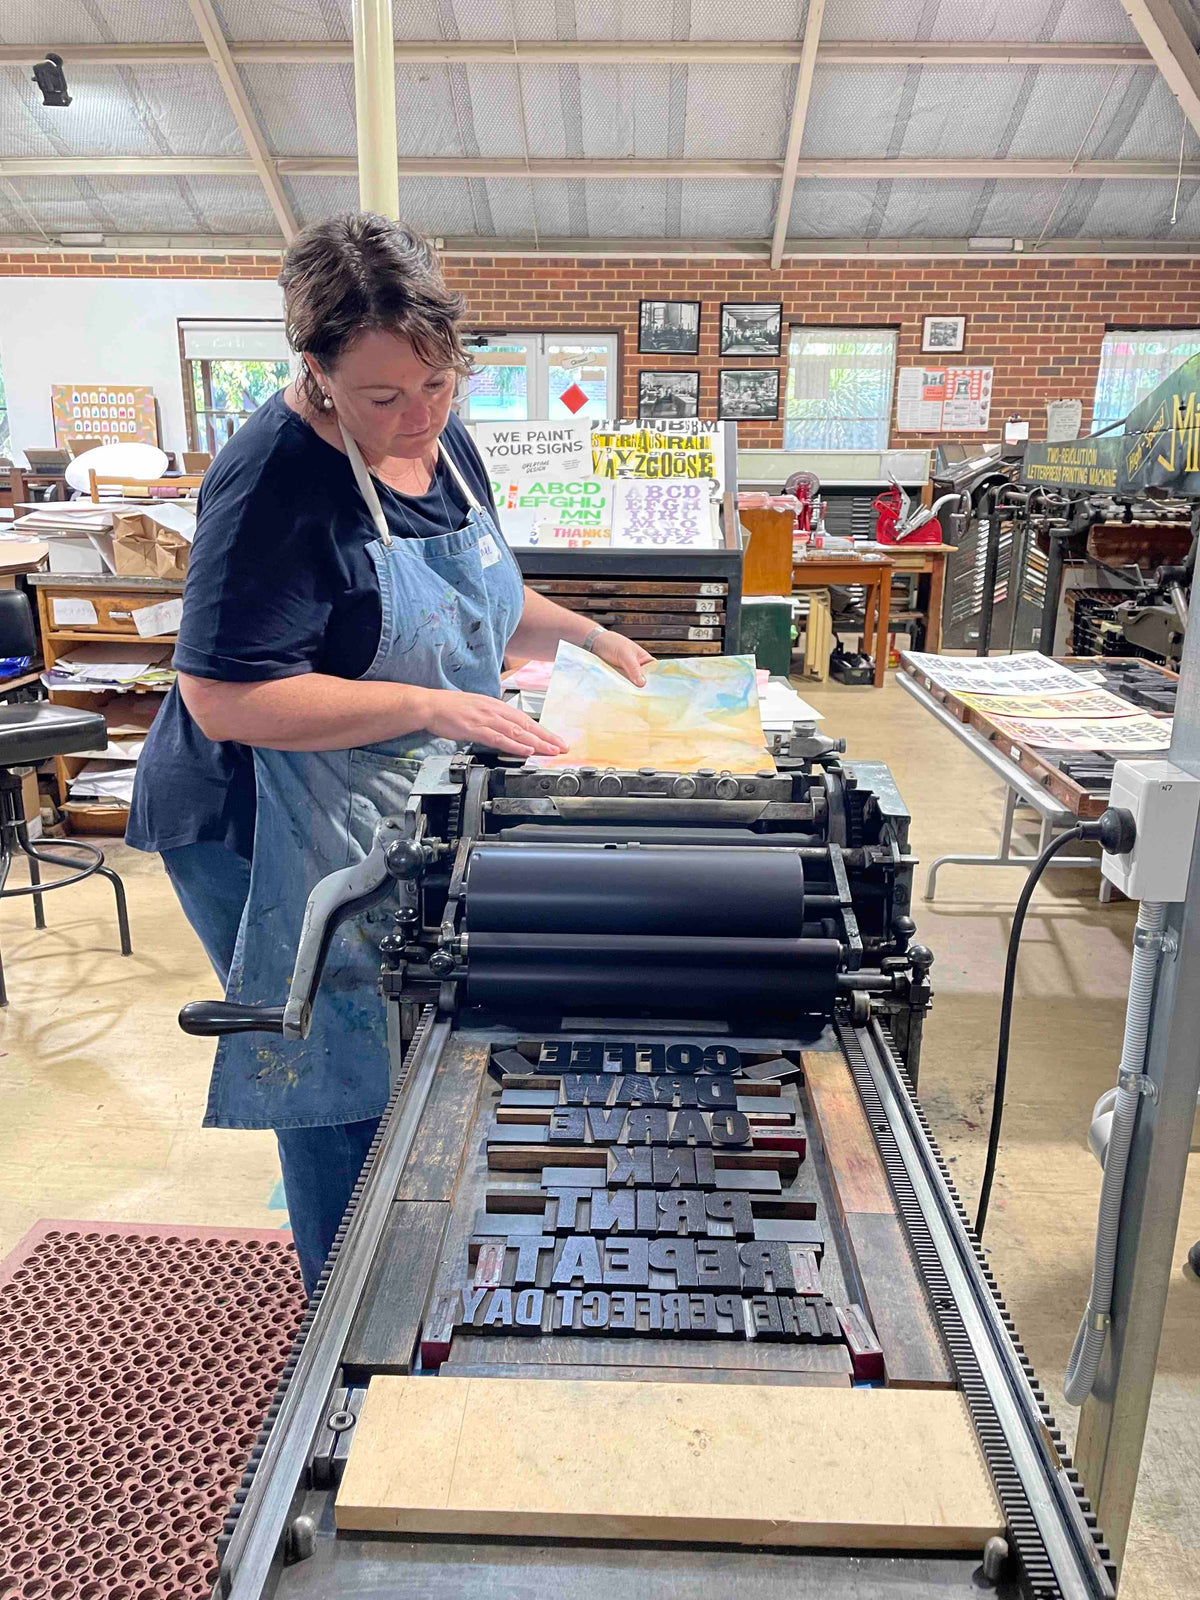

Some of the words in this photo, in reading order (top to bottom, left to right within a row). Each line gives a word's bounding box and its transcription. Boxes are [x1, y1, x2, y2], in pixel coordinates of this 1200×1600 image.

[493, 431, 520, 443] WE
[527, 429, 574, 442] PAINT
[485, 444, 533, 457] YOUR
[536, 441, 583, 455] SIGNS
[528, 482, 602, 495] ABCD
[519, 496, 606, 509] EFGHIJ
[553, 528, 611, 539] THANKS
